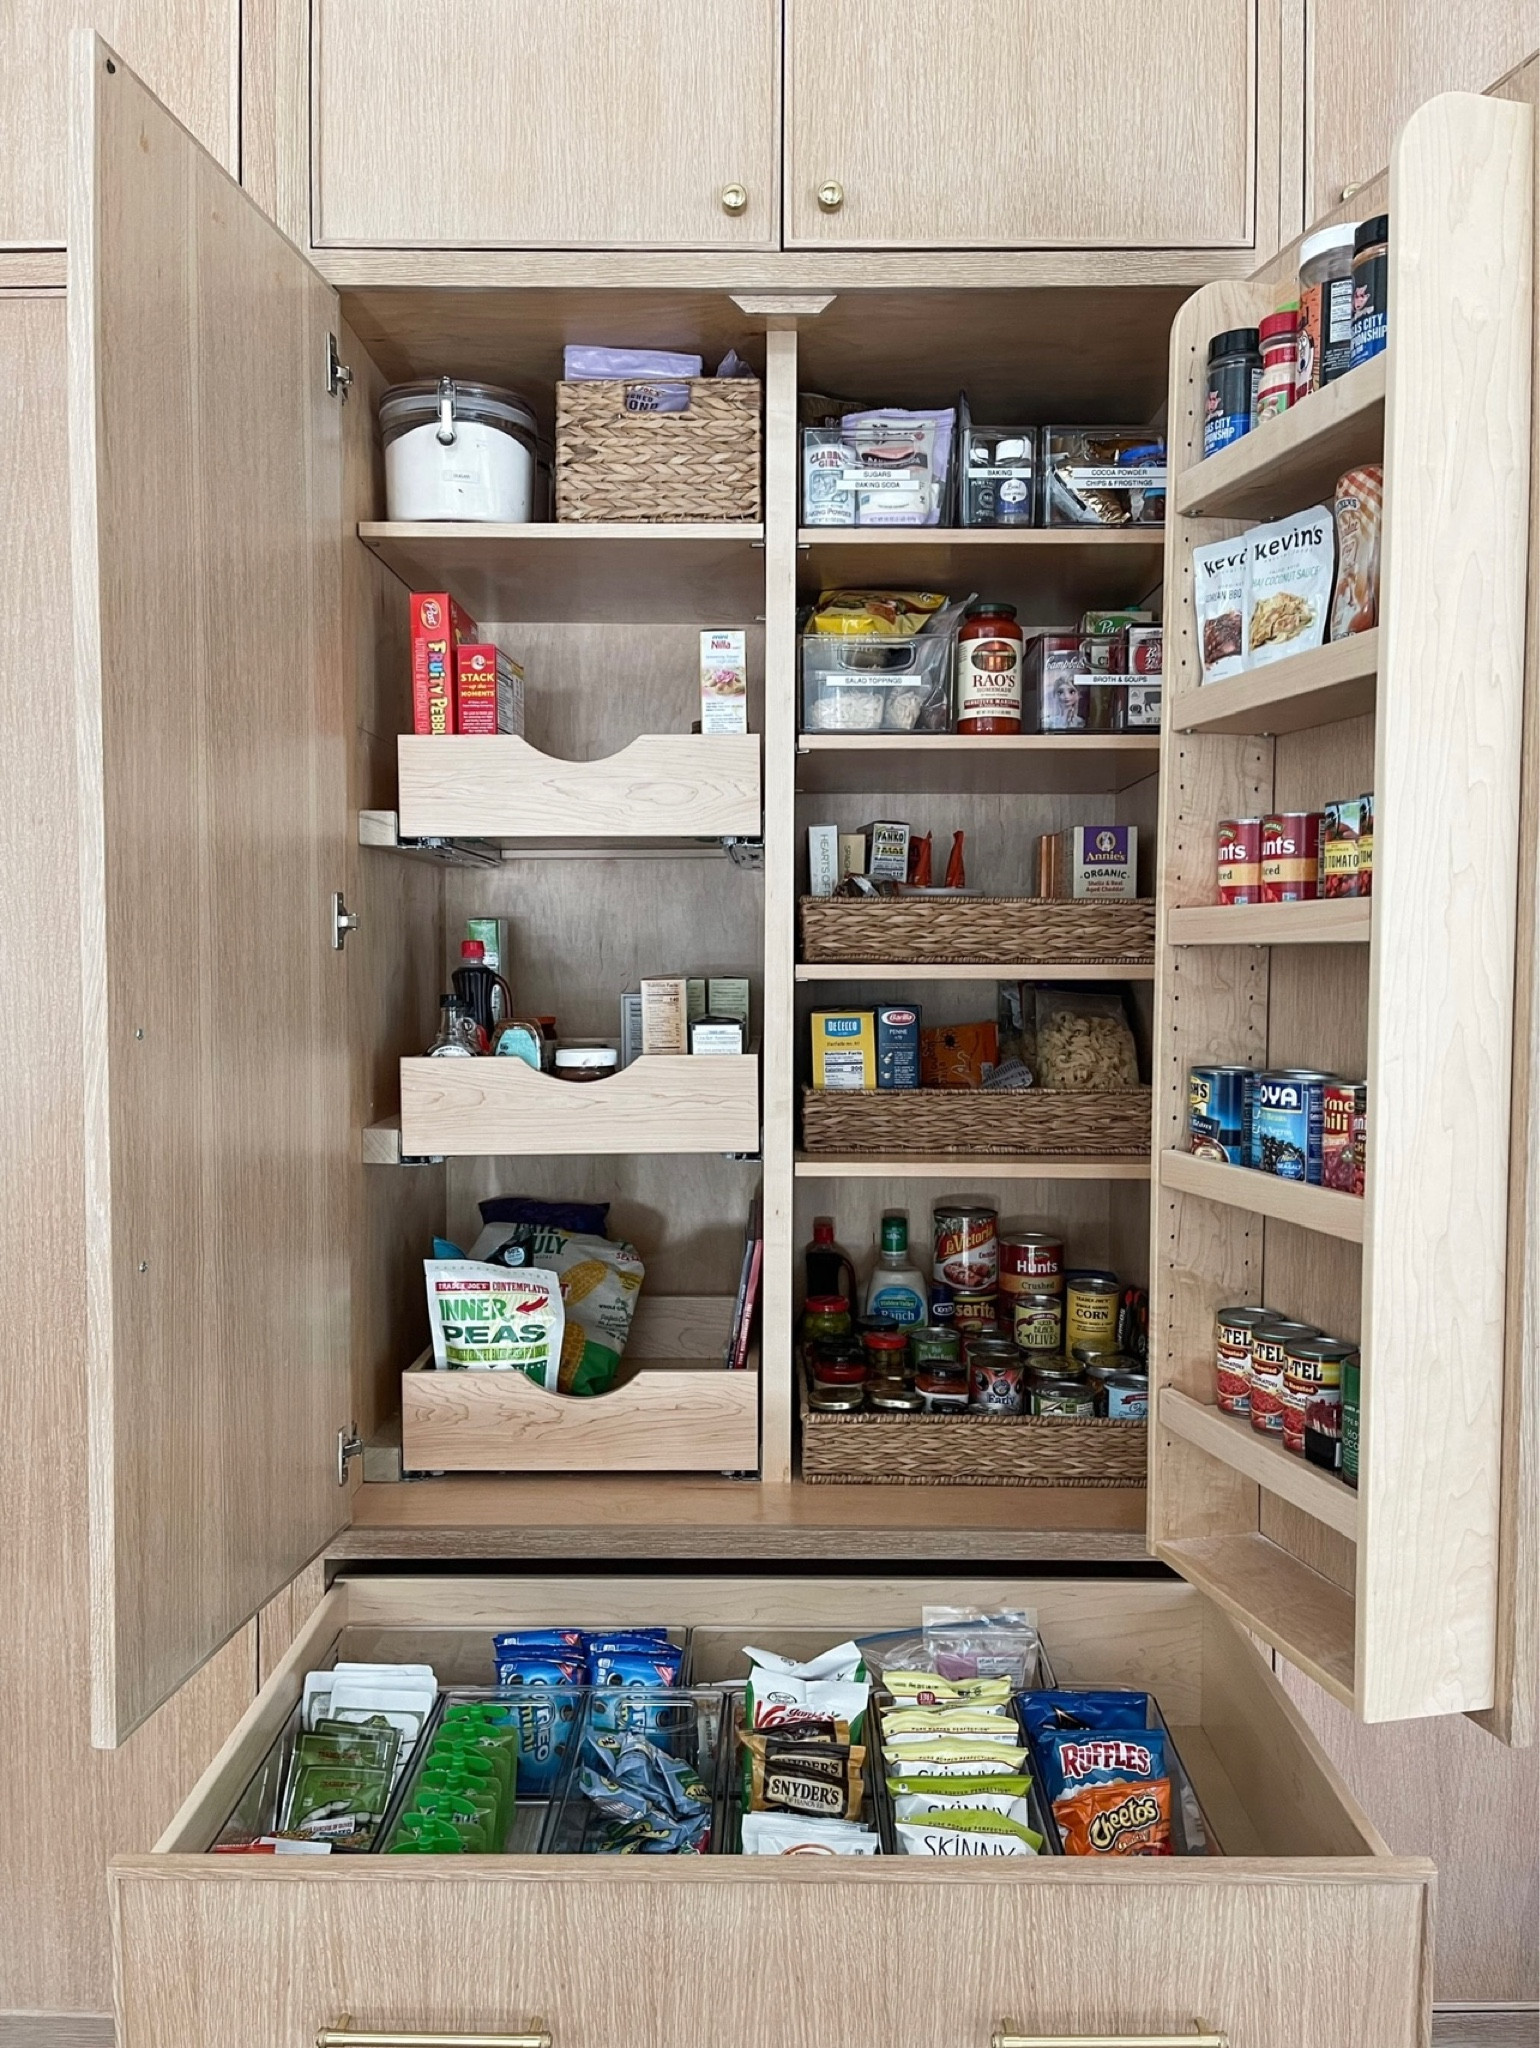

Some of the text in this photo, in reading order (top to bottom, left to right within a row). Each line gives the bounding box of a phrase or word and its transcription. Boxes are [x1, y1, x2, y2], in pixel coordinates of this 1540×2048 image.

[818, 459, 840, 468] GIRL
[987, 469, 1013, 477] BAKING
[1264, 570, 1297, 587] COCONUT
[461, 673, 494, 682] STACK
[972, 673, 1016, 688] RAO'S
[877, 831, 904, 843] PANKO
[819, 833, 831, 874] HEARTS
[1086, 850, 1127, 862] Annie's
[1083, 868, 1128, 879] ORGANIC
[889, 1013, 913, 1022] Barilla
[438, 1282, 465, 1290] TRADER
[492, 1281, 550, 1294] CONTEMPLATES
[1022, 1281, 1055, 1290] Crushed
[438, 1298, 507, 1322] INNER
[1076, 1309, 1109, 1319] CORN
[441, 1324, 547, 1344] PEAS
[1028, 1333, 1058, 1344] OLIVES
[1060, 1741, 1151, 1779] RUFFLES
[771, 1778, 840, 1806] SNYDER'S
[1089, 1795, 1159, 1851] Cheetos
[924, 1833, 1017, 1856] SKINNY
